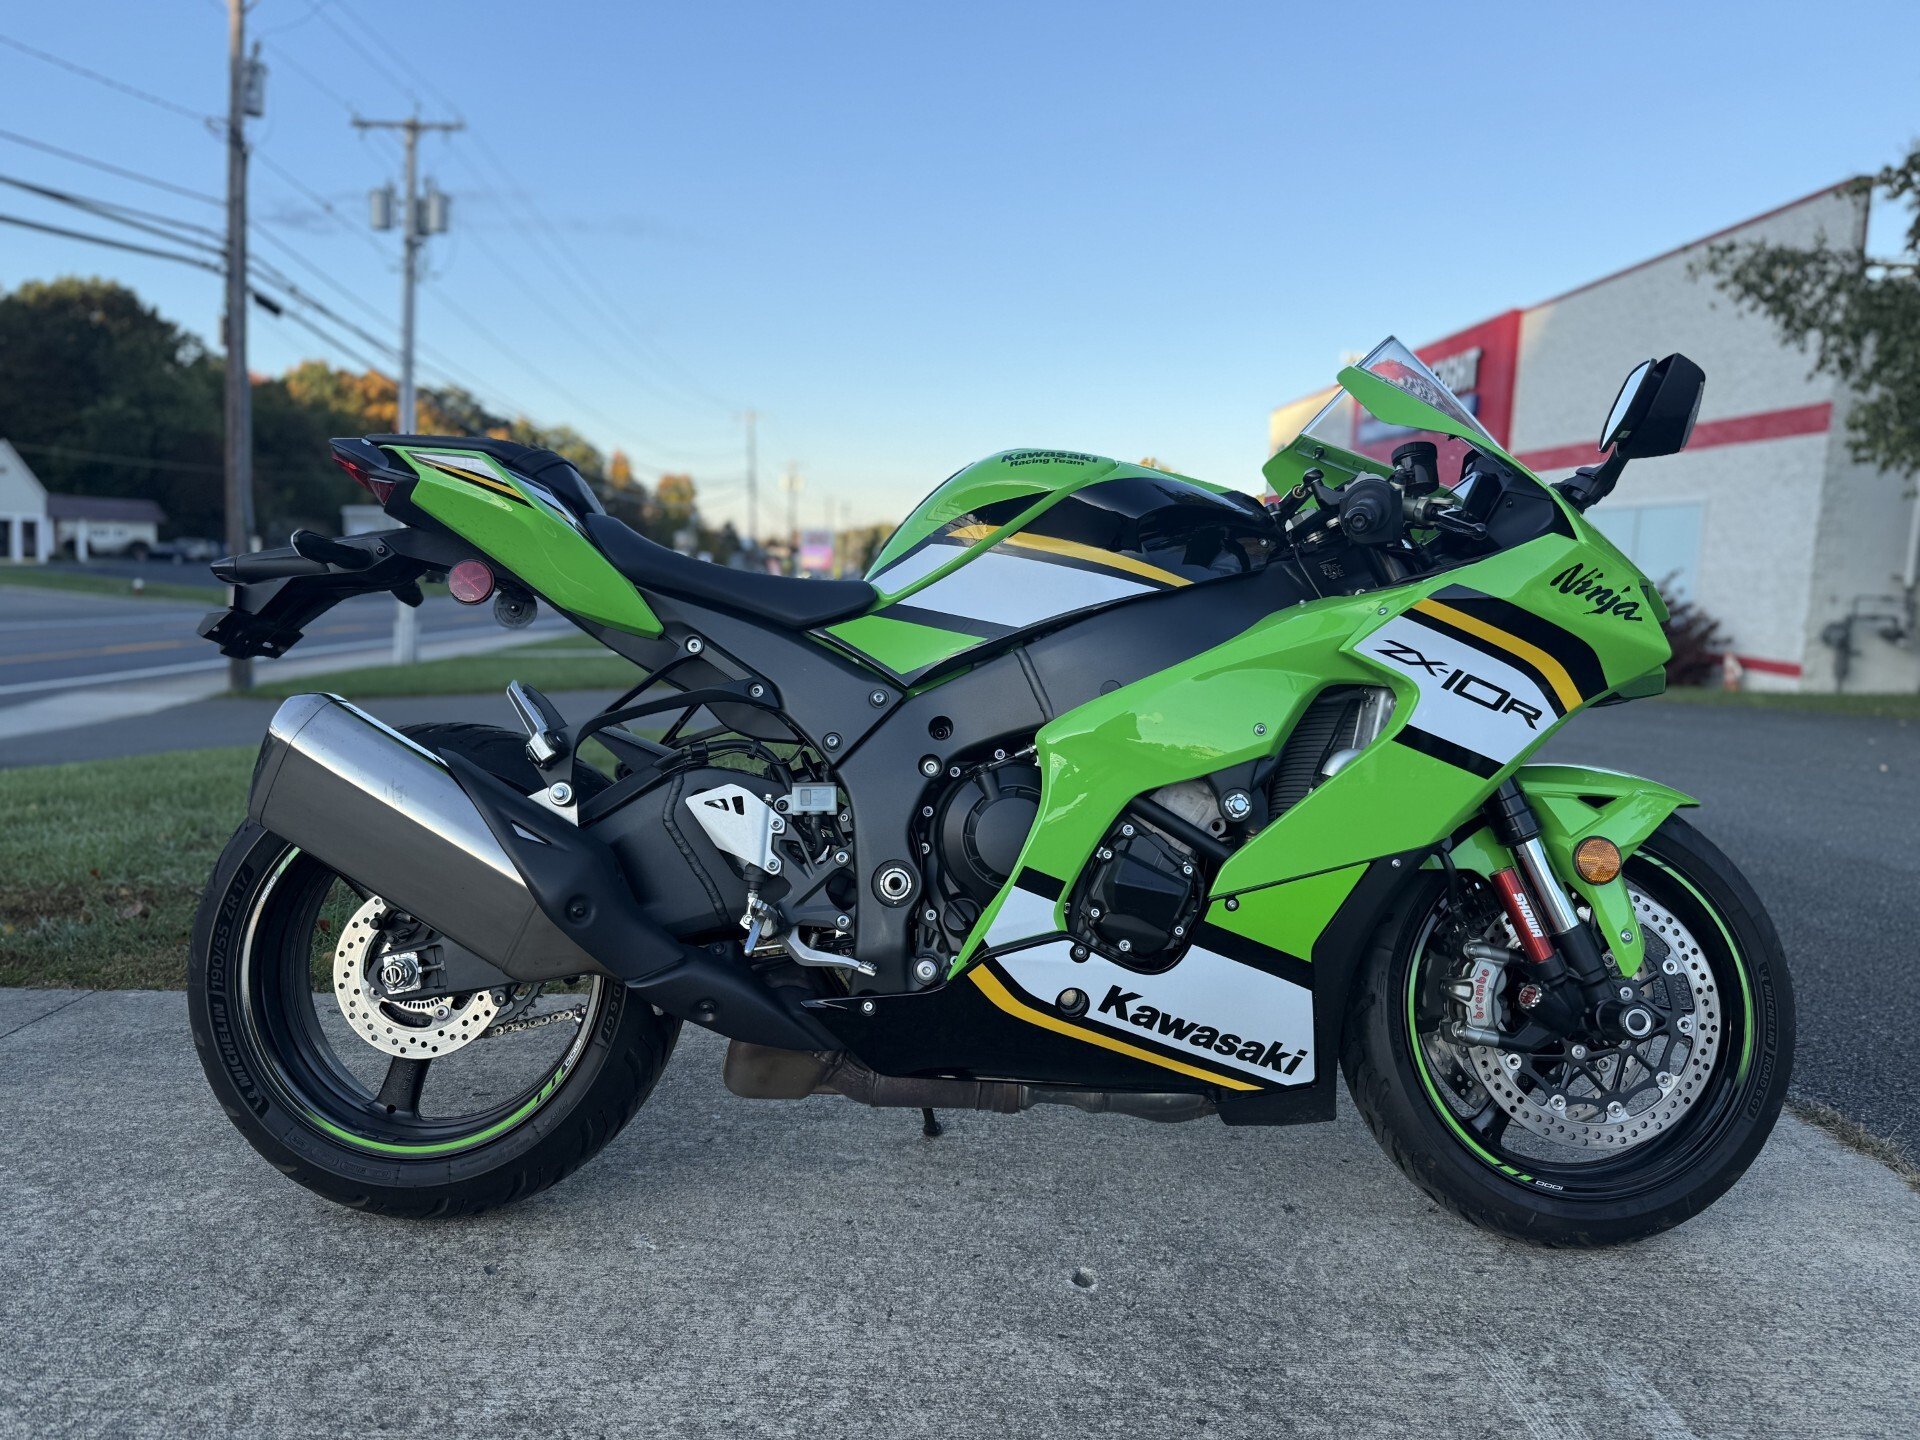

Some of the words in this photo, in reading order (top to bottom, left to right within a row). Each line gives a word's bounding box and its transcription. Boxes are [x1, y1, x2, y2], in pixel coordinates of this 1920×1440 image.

[1001, 451, 1099, 463] Kawasaki
[1010, 458, 1050, 467] Racing
[1053, 457, 1085, 466] Team
[1550, 563, 1642, 621] Ninja
[1373, 639, 1543, 730] ZX-10R
[234, 870, 249, 891] 17
[222, 893, 240, 918] ZR
[1513, 893, 1544, 938] SHOWA
[210, 923, 230, 989] 190/55
[1473, 969, 1489, 1019] brembo
[602, 1016, 615, 1039] GT
[1761, 981, 1776, 1046] MICHELIN
[210, 1002, 252, 1090] MICHELIN
[1098, 984, 1308, 1076] Kawasaki
[1760, 1056, 1772, 1088] ROAD
[1749, 1100, 1760, 1115] GT
[1756, 1089, 1764, 1099] 6
[1535, 1181, 1563, 1190] 1000
